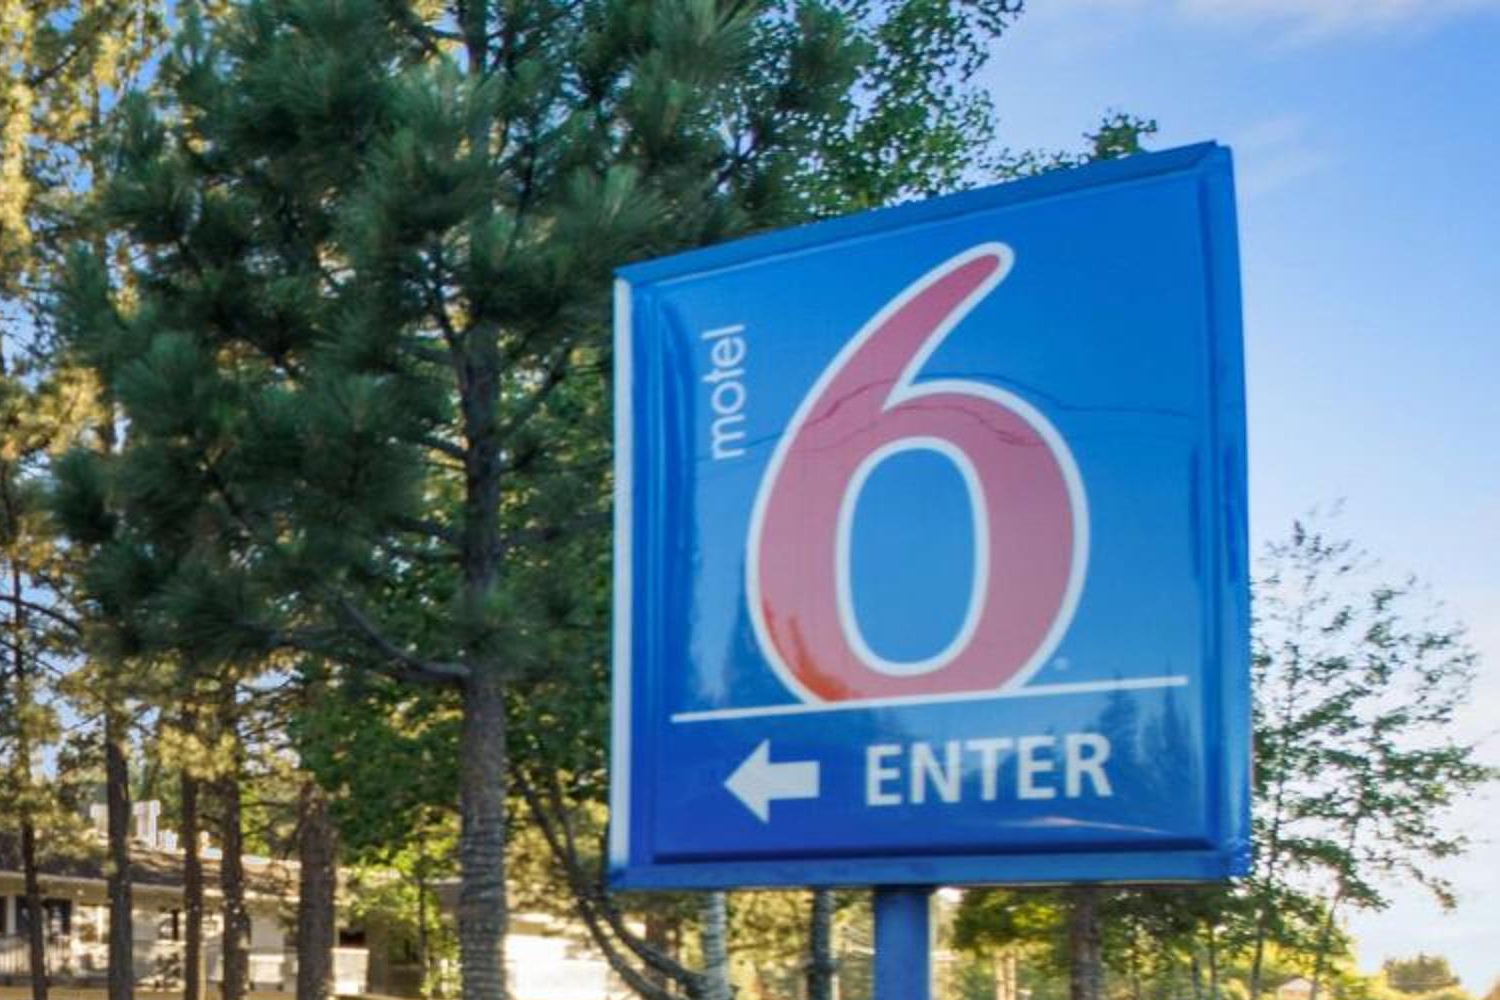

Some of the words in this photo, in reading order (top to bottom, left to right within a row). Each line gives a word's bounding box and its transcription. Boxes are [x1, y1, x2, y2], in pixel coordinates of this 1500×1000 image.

[704, 325, 745, 461] motel
[746, 242, 1088, 704] 6
[866, 734, 1112, 806] ENTER
